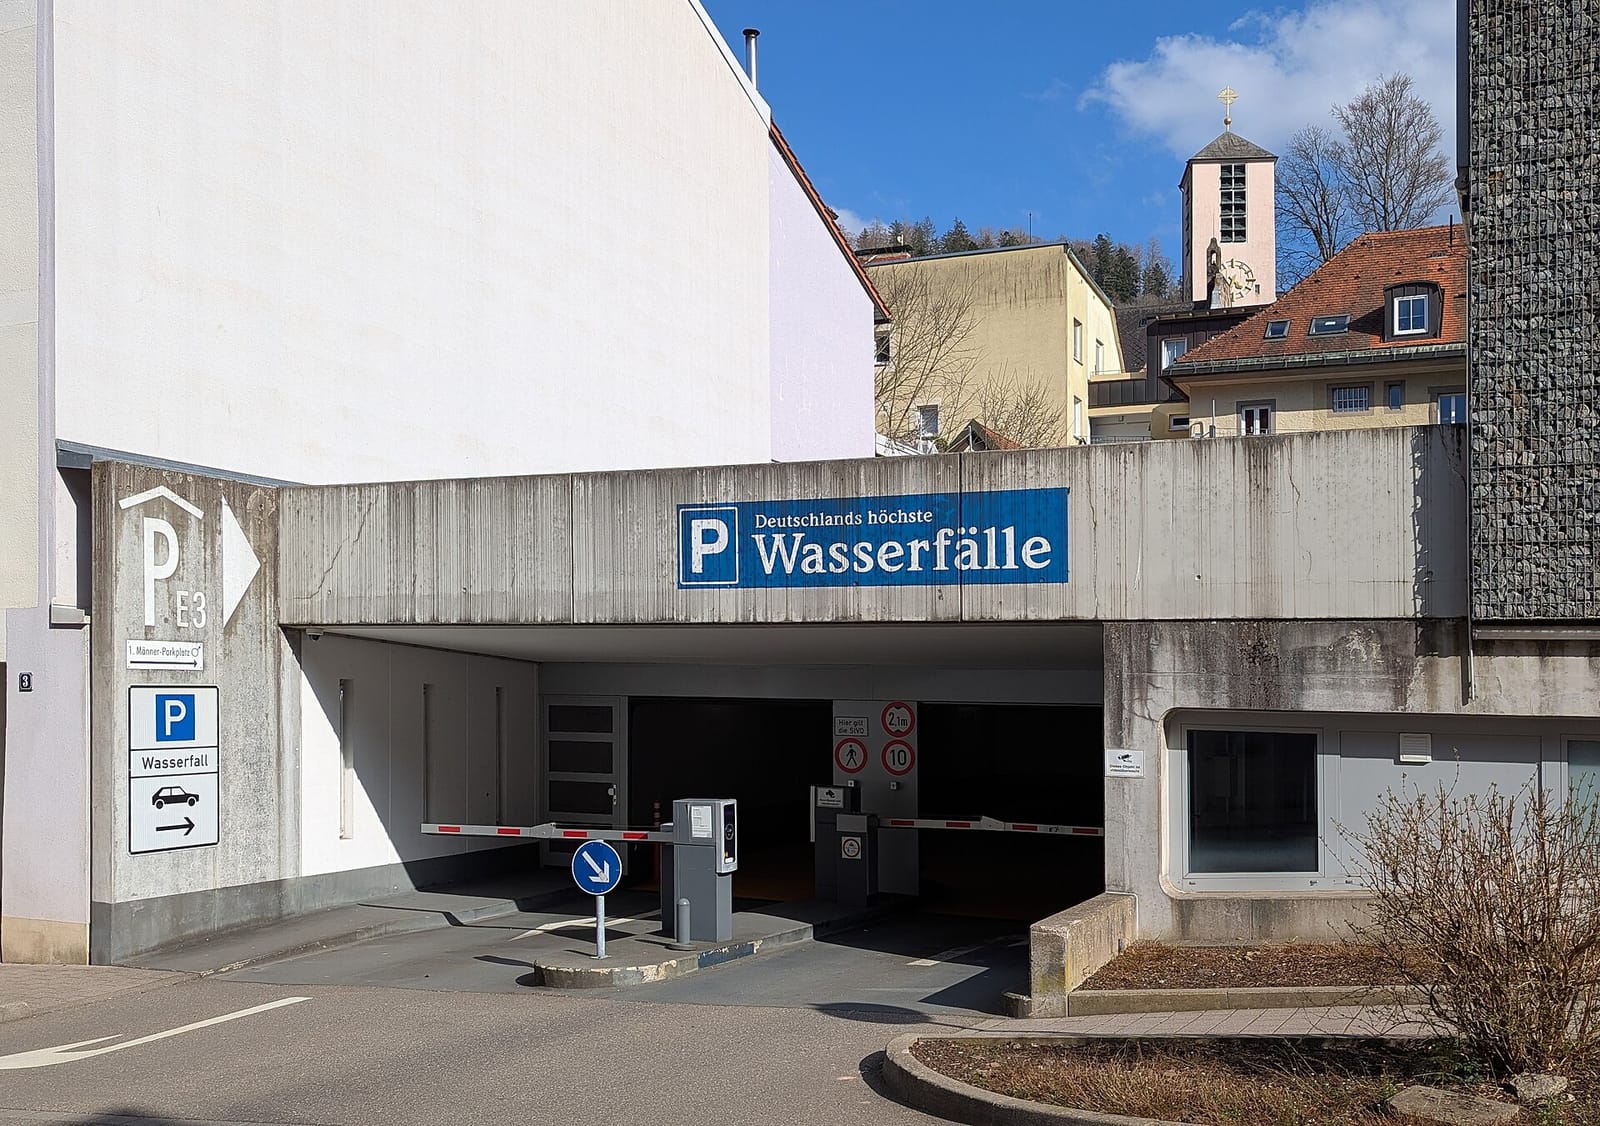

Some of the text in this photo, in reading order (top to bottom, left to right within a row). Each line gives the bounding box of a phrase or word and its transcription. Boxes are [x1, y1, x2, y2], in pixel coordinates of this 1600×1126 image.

[755, 509, 933, 529] Deutschlands höchste
[691, 518, 729, 574] P
[752, 525, 1052, 576] Wasserfälle
[144, 516, 207, 629] P E3
[136, 646, 190, 658] Männer-Parkplatz
[22, 675, 28, 687] 3
[165, 700, 186, 736] P
[141, 754, 208, 770] Wasserfall
[890, 749, 907, 766] 10
